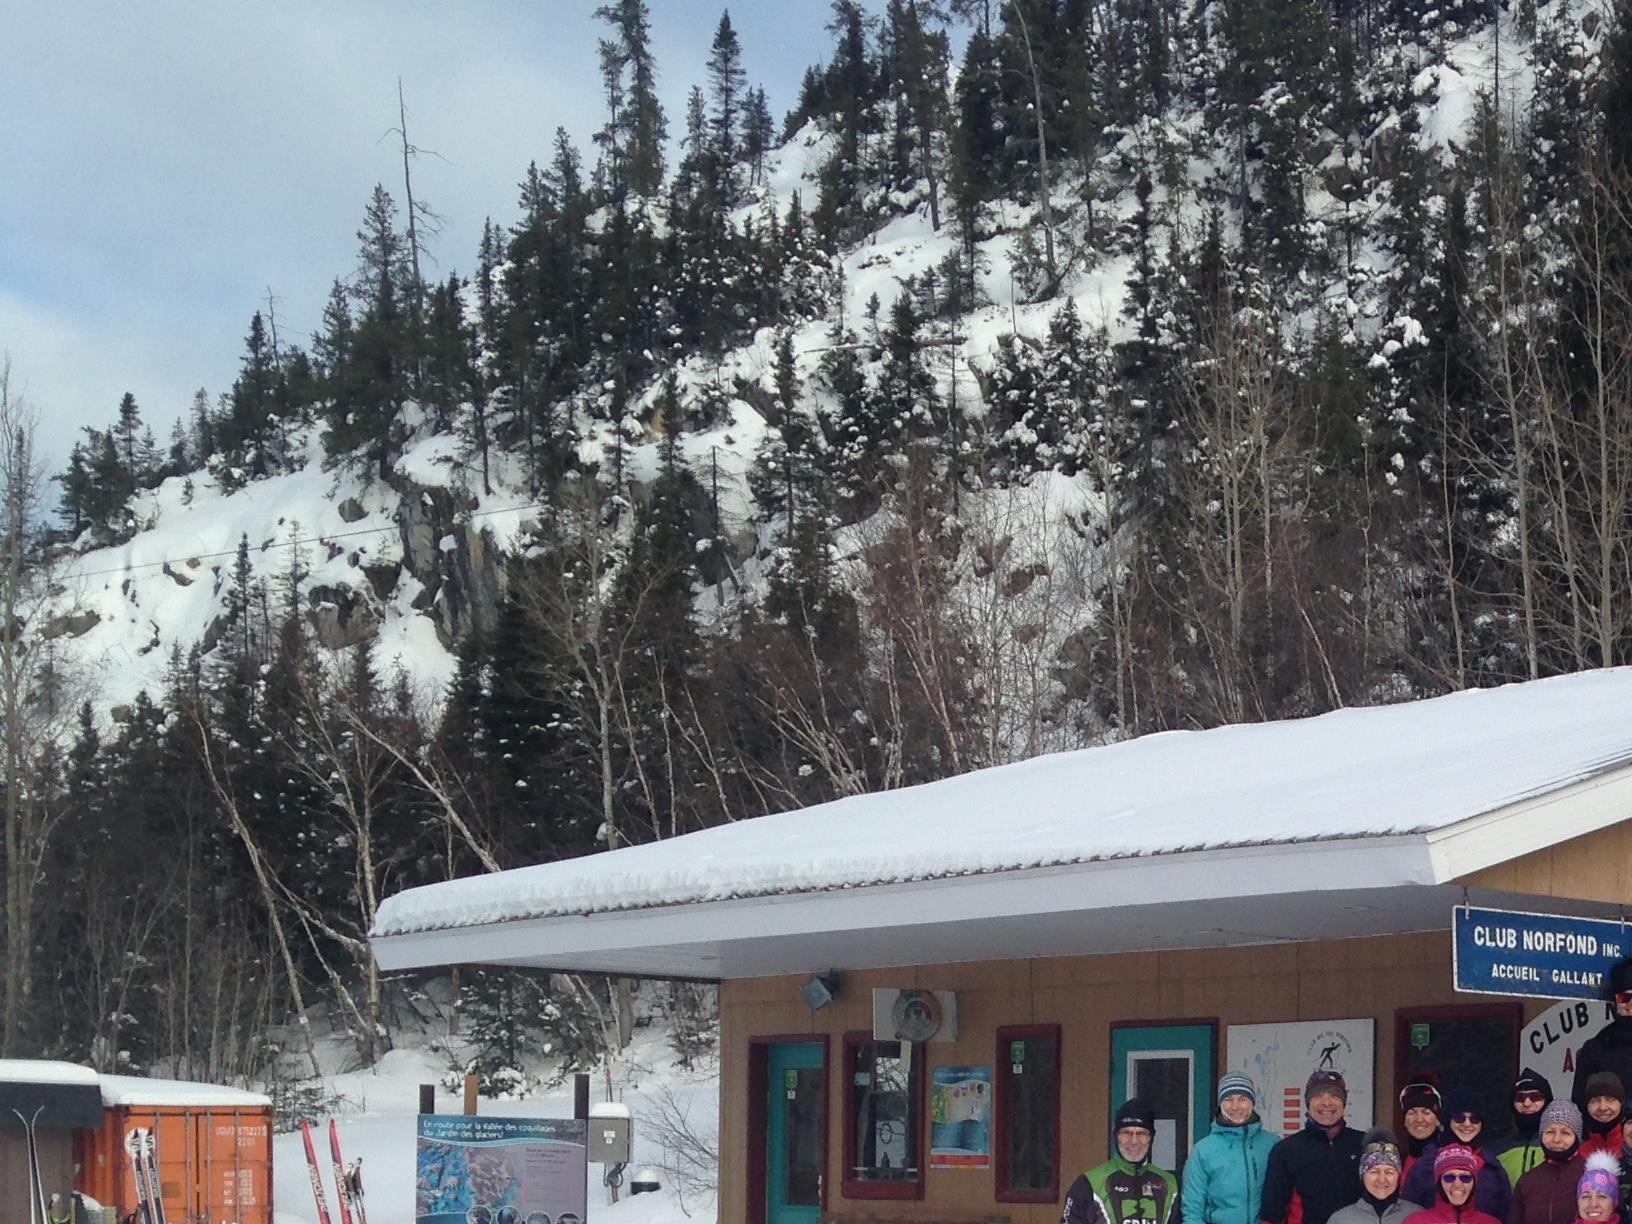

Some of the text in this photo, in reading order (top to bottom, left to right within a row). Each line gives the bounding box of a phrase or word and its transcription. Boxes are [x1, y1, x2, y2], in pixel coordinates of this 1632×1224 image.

[1474, 925, 1624, 959] CLUB NORFOND INC.
[1491, 963, 1604, 986] ACCUEIL GALLANT
[1529, 1002, 1590, 1055] CLUB
